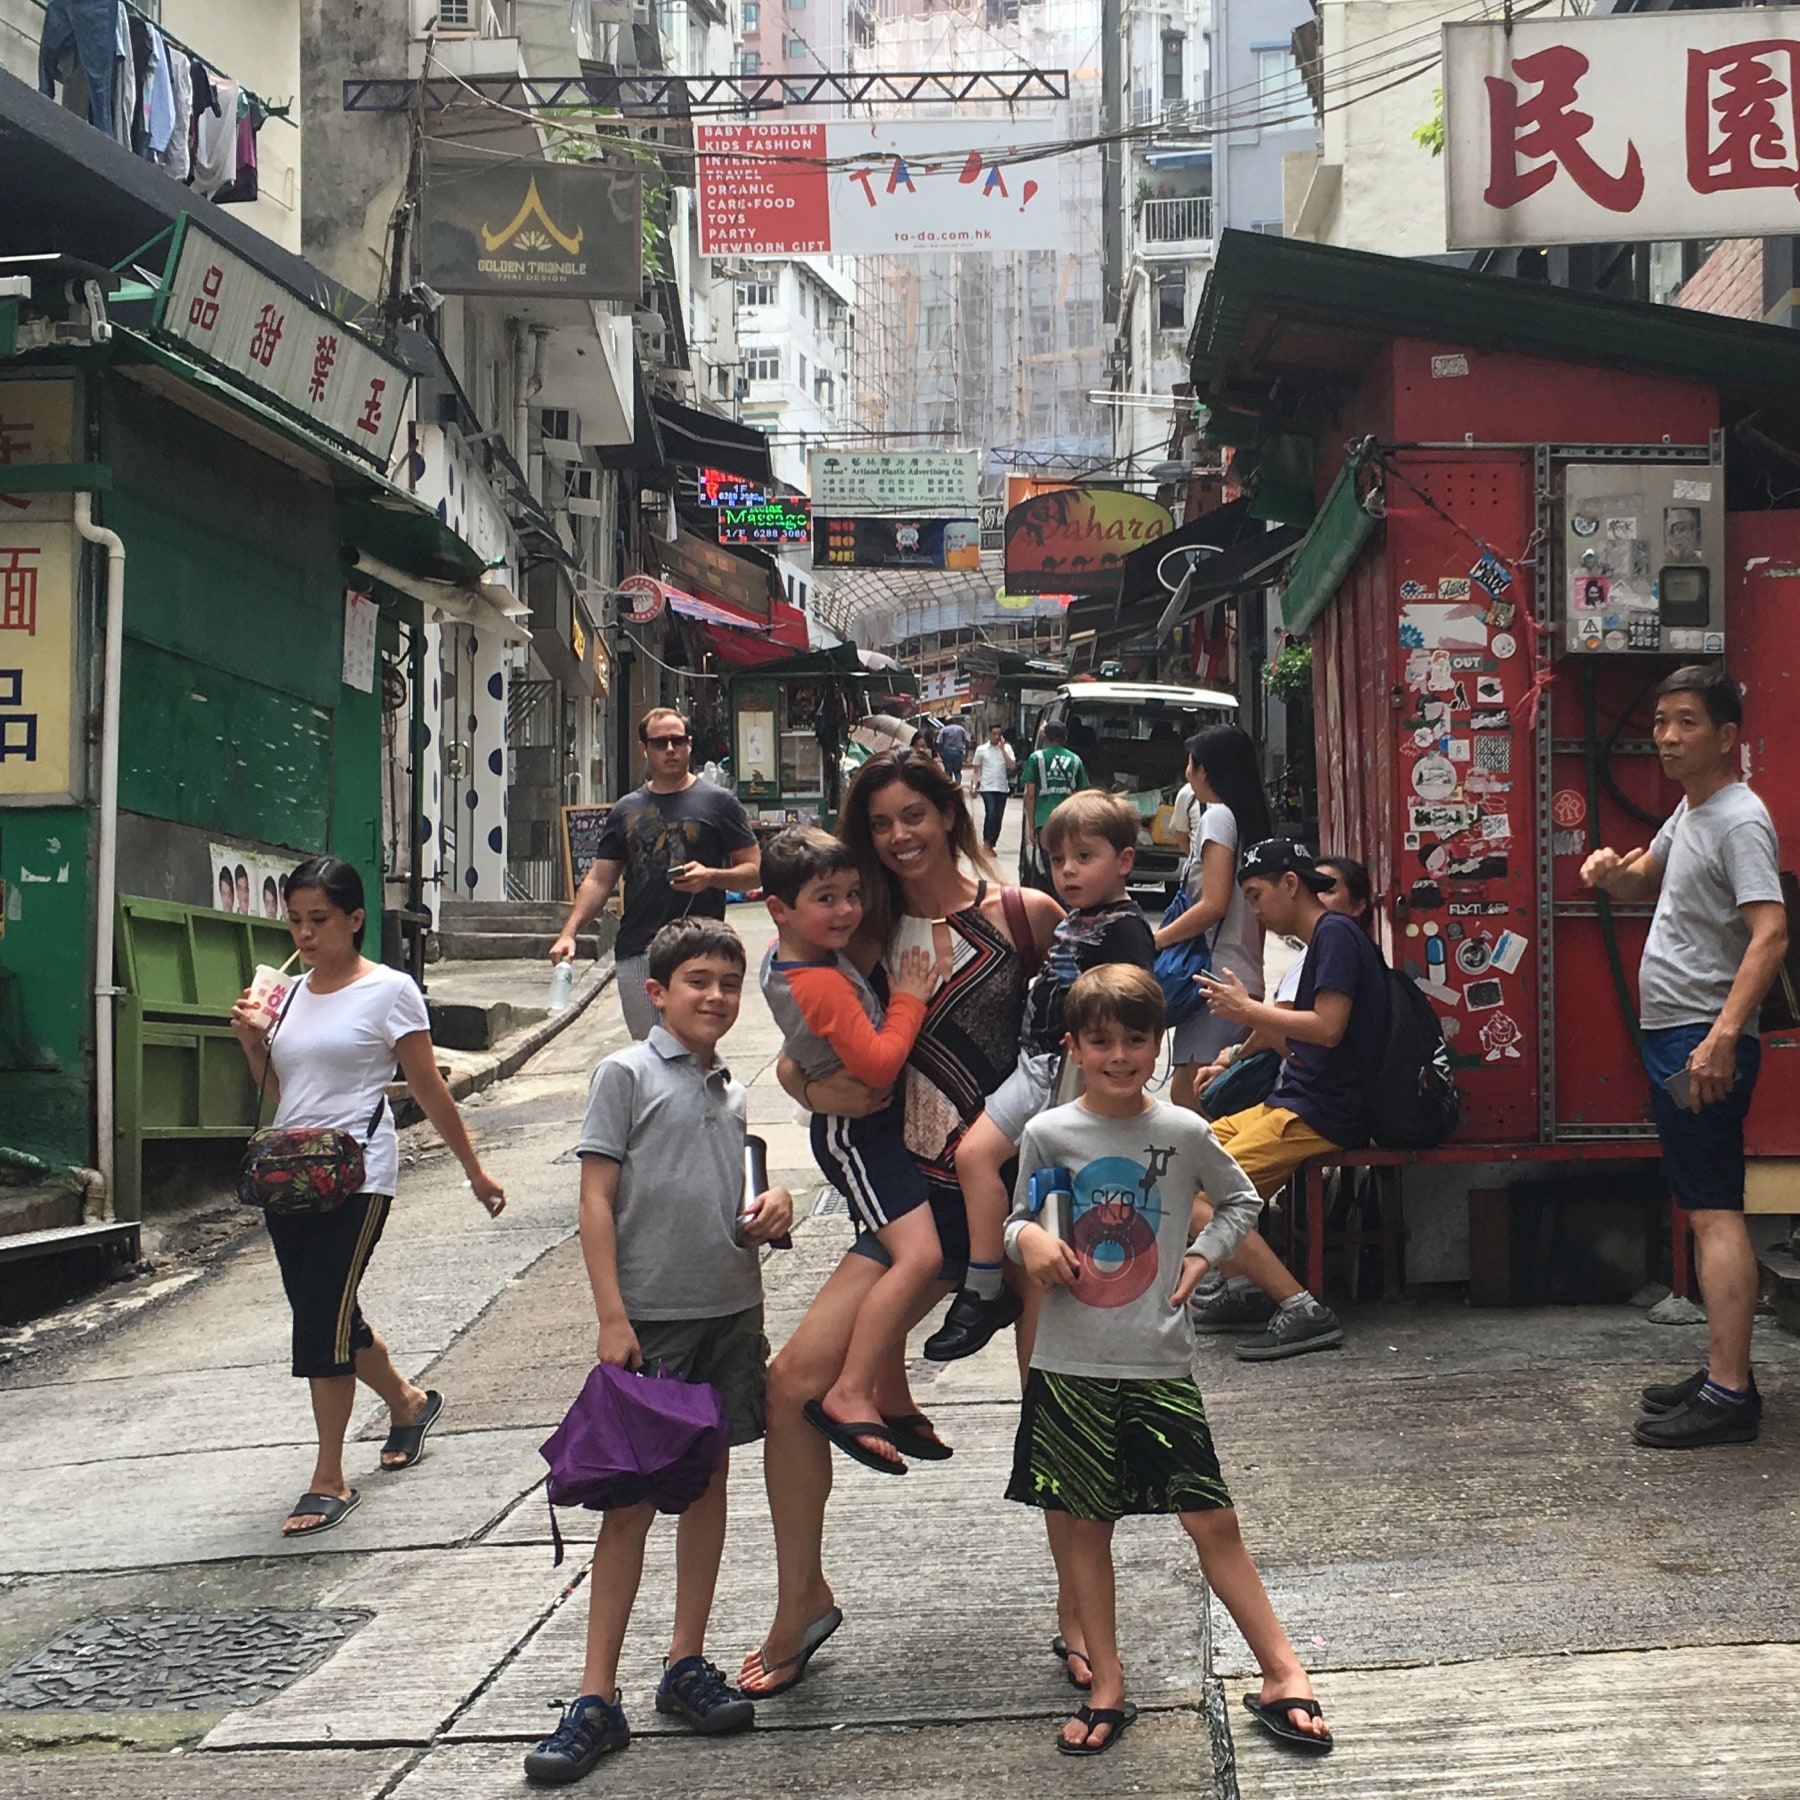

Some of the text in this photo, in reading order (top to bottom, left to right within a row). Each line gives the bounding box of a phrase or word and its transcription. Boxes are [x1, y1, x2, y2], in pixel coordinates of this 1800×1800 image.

[704, 125, 818, 137] BABY TODDLER
[705, 139, 812, 151] KIDS FASHION
[705, 154, 778, 166] INTERIOR
[706, 169, 762, 180] TRAVEL
[707, 184, 775, 195] ORGANIC
[708, 213, 746, 224] TOYS
[709, 228, 757, 239] PARTY
[894, 229, 992, 242] ta-da.com.hk
[709, 241, 825, 254] NEWBORN GIFT
[477, 259, 587, 275] GOLDEN TRIANGLE
[497, 272, 568, 282] THAI DESIGN
[908, 468, 950, 477] Advertising
[725, 528, 807, 537] 1/F 6288 3080
[1453, 657, 1481, 668] OUT
